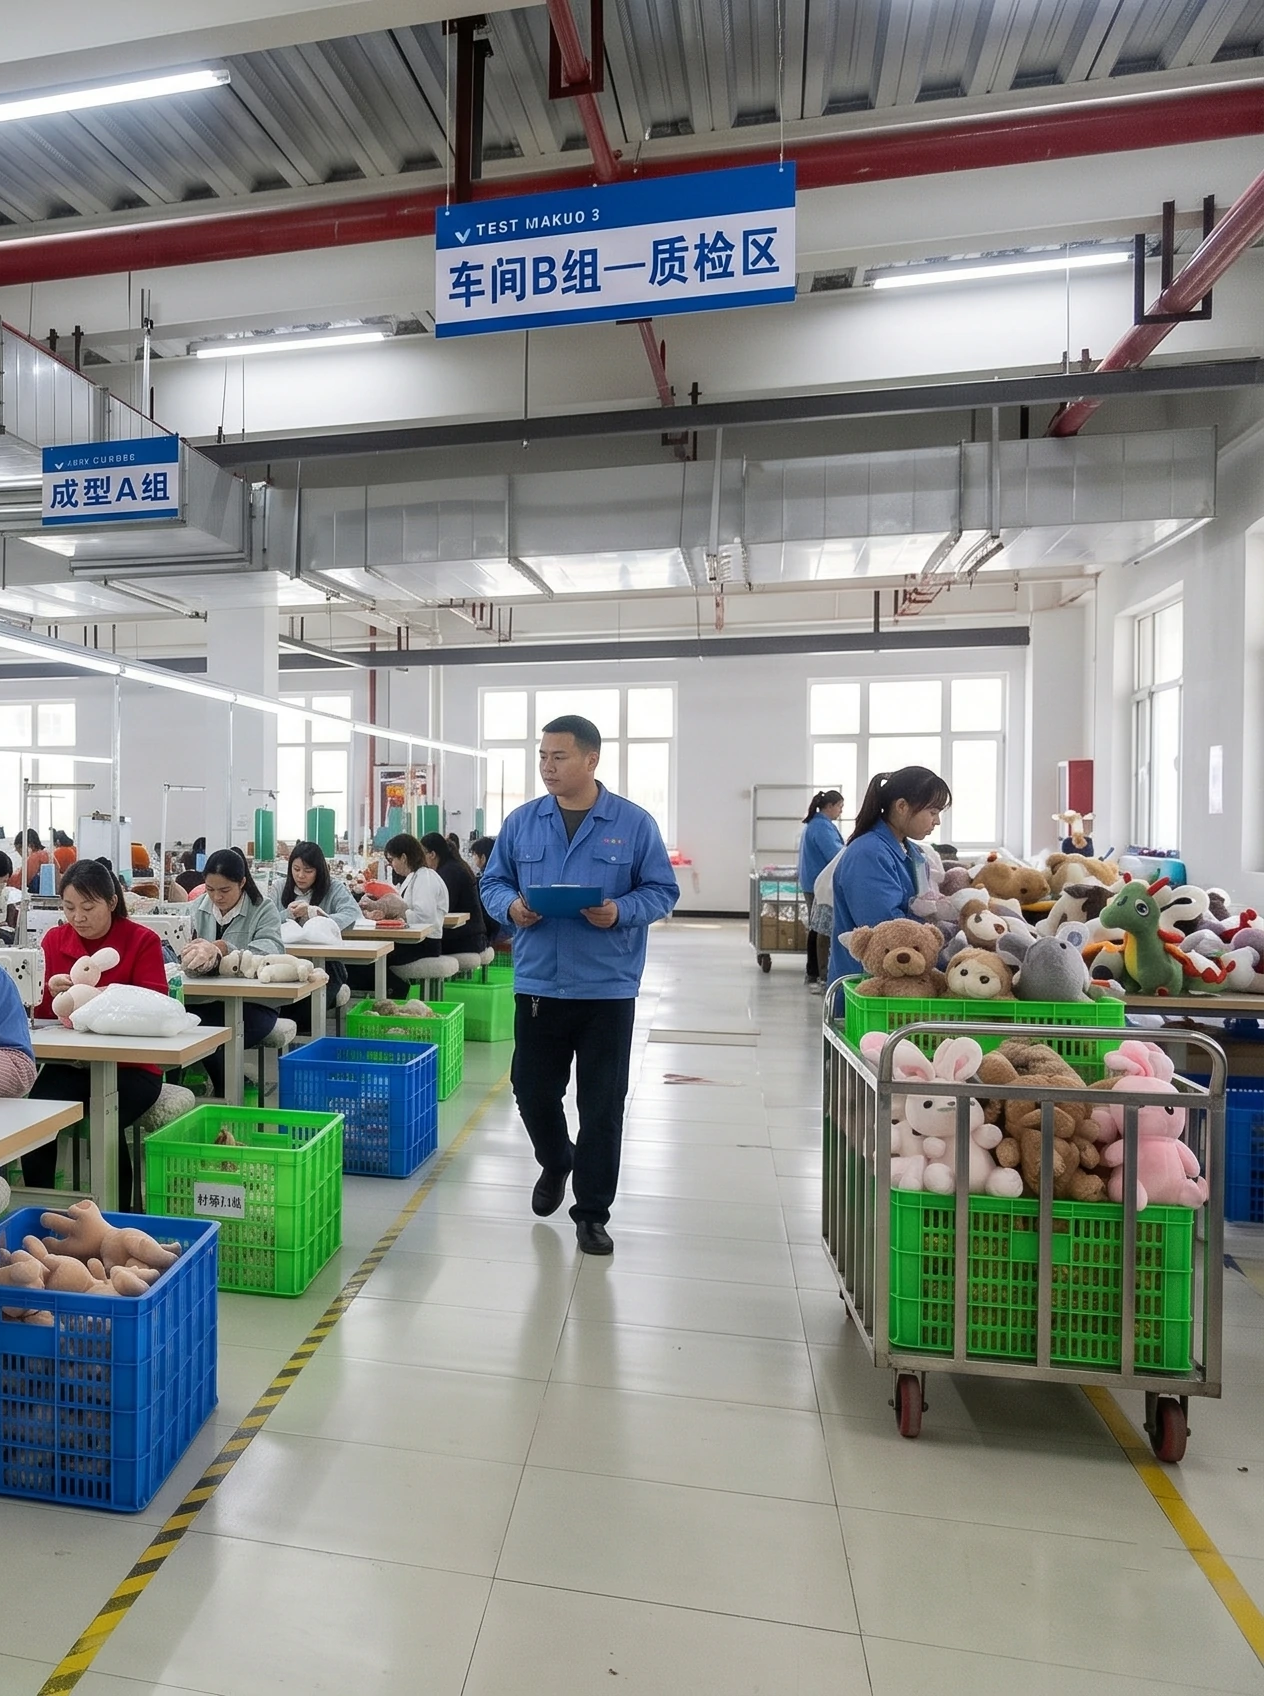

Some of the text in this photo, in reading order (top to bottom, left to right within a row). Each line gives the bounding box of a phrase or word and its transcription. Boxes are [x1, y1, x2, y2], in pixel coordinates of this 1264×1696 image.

[476, 208, 600, 236] TEST MAKUO 3
[50, 472, 170, 509] 成型A组
